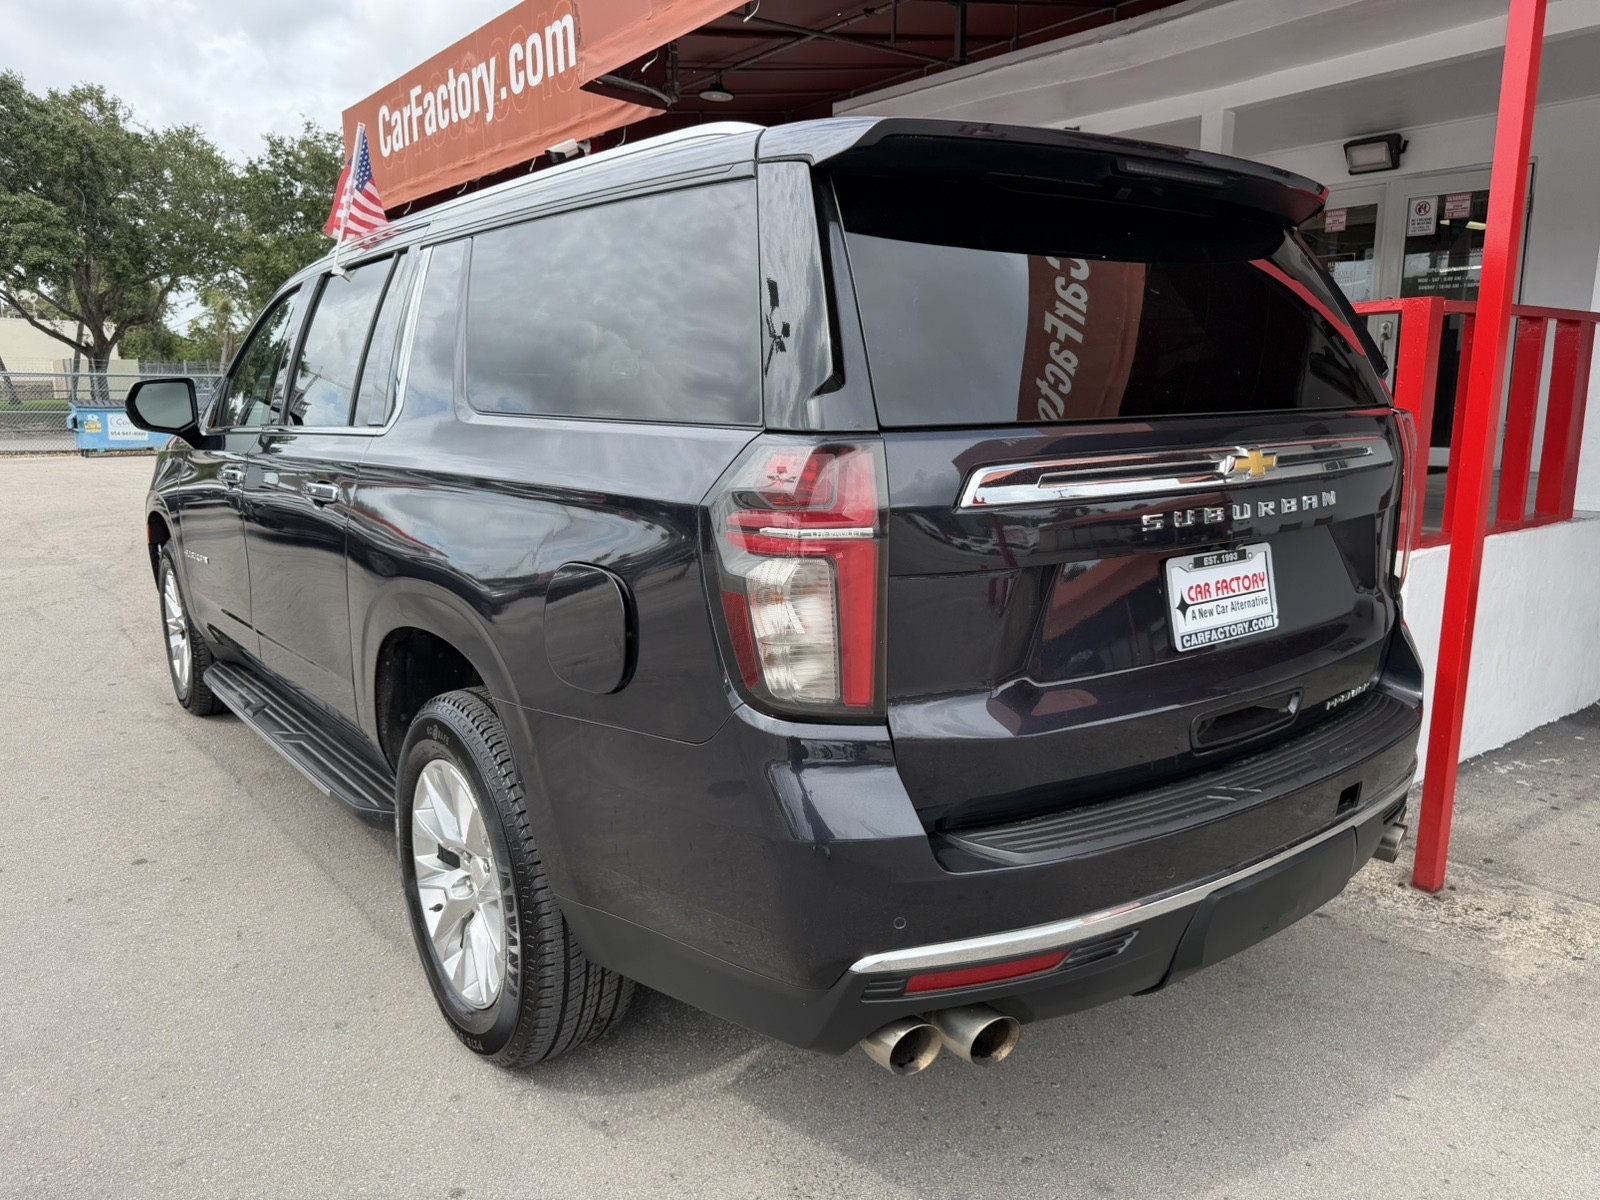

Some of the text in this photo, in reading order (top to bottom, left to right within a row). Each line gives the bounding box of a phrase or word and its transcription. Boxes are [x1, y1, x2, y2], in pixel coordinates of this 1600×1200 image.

[378, 13, 577, 158] CarFactory.com
[1141, 490, 1336, 532] SUBURBAN
[1203, 552, 1239, 566] EST. 1993
[1187, 571, 1266, 602] CAR FACTORY
[1191, 595, 1269, 621] A New Car Alternative
[1182, 615, 1274, 648] CARFACTORY.COM
